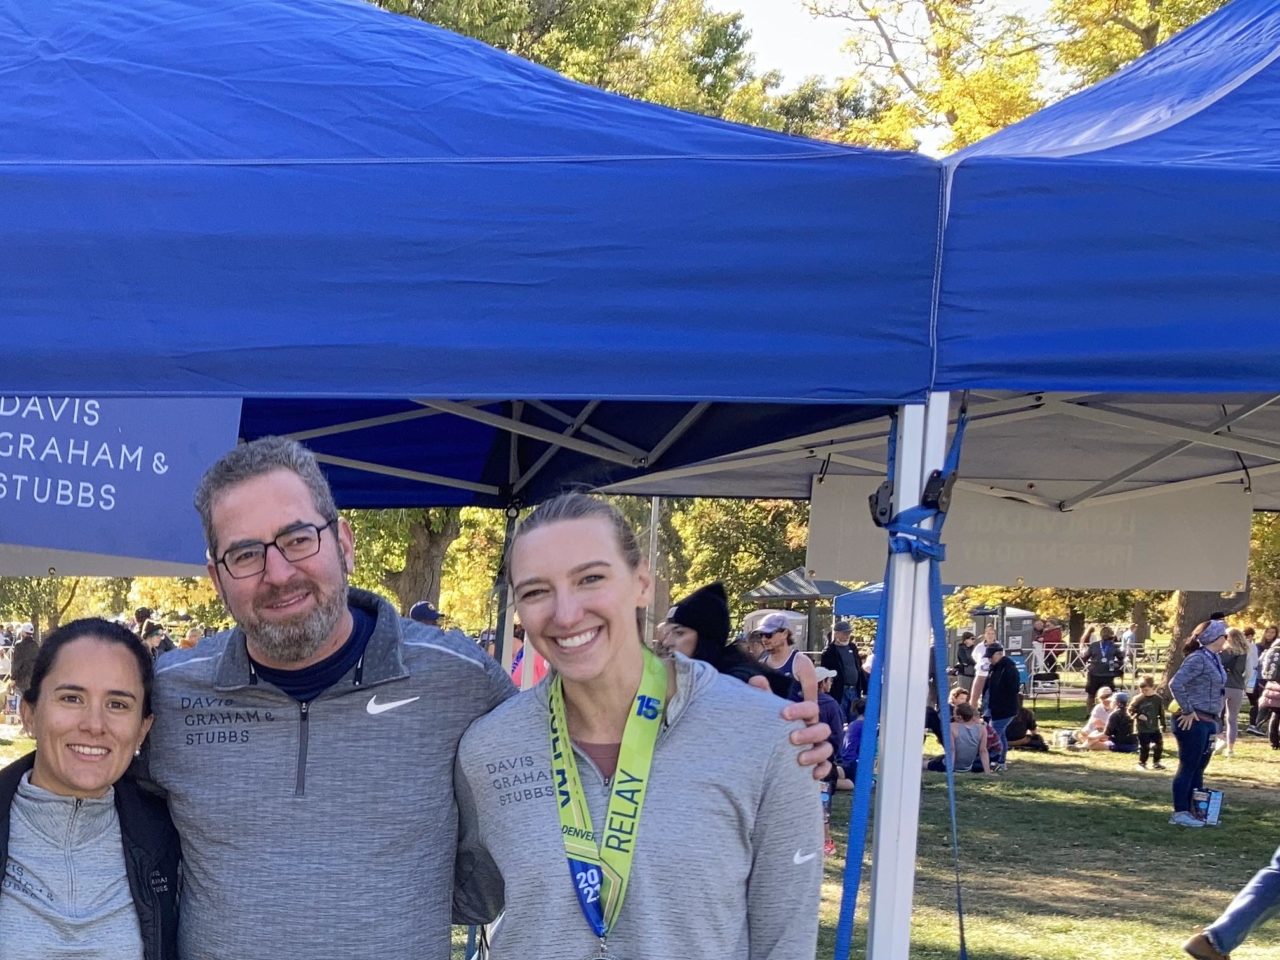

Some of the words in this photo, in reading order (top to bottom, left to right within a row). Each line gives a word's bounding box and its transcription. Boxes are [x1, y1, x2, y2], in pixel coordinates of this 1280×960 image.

[152, 451, 169, 475] &
[183, 710, 261, 727] GRAHAM
[635, 694, 662, 721] 15
[185, 730, 250, 746] STUBBS
[485, 755, 535, 775] DAVIS
[492, 769, 554, 790] GRAHA
[498, 785, 555, 807] STUBBS
[605, 767, 644, 854] RELAY
[575, 867, 600, 890] 20
